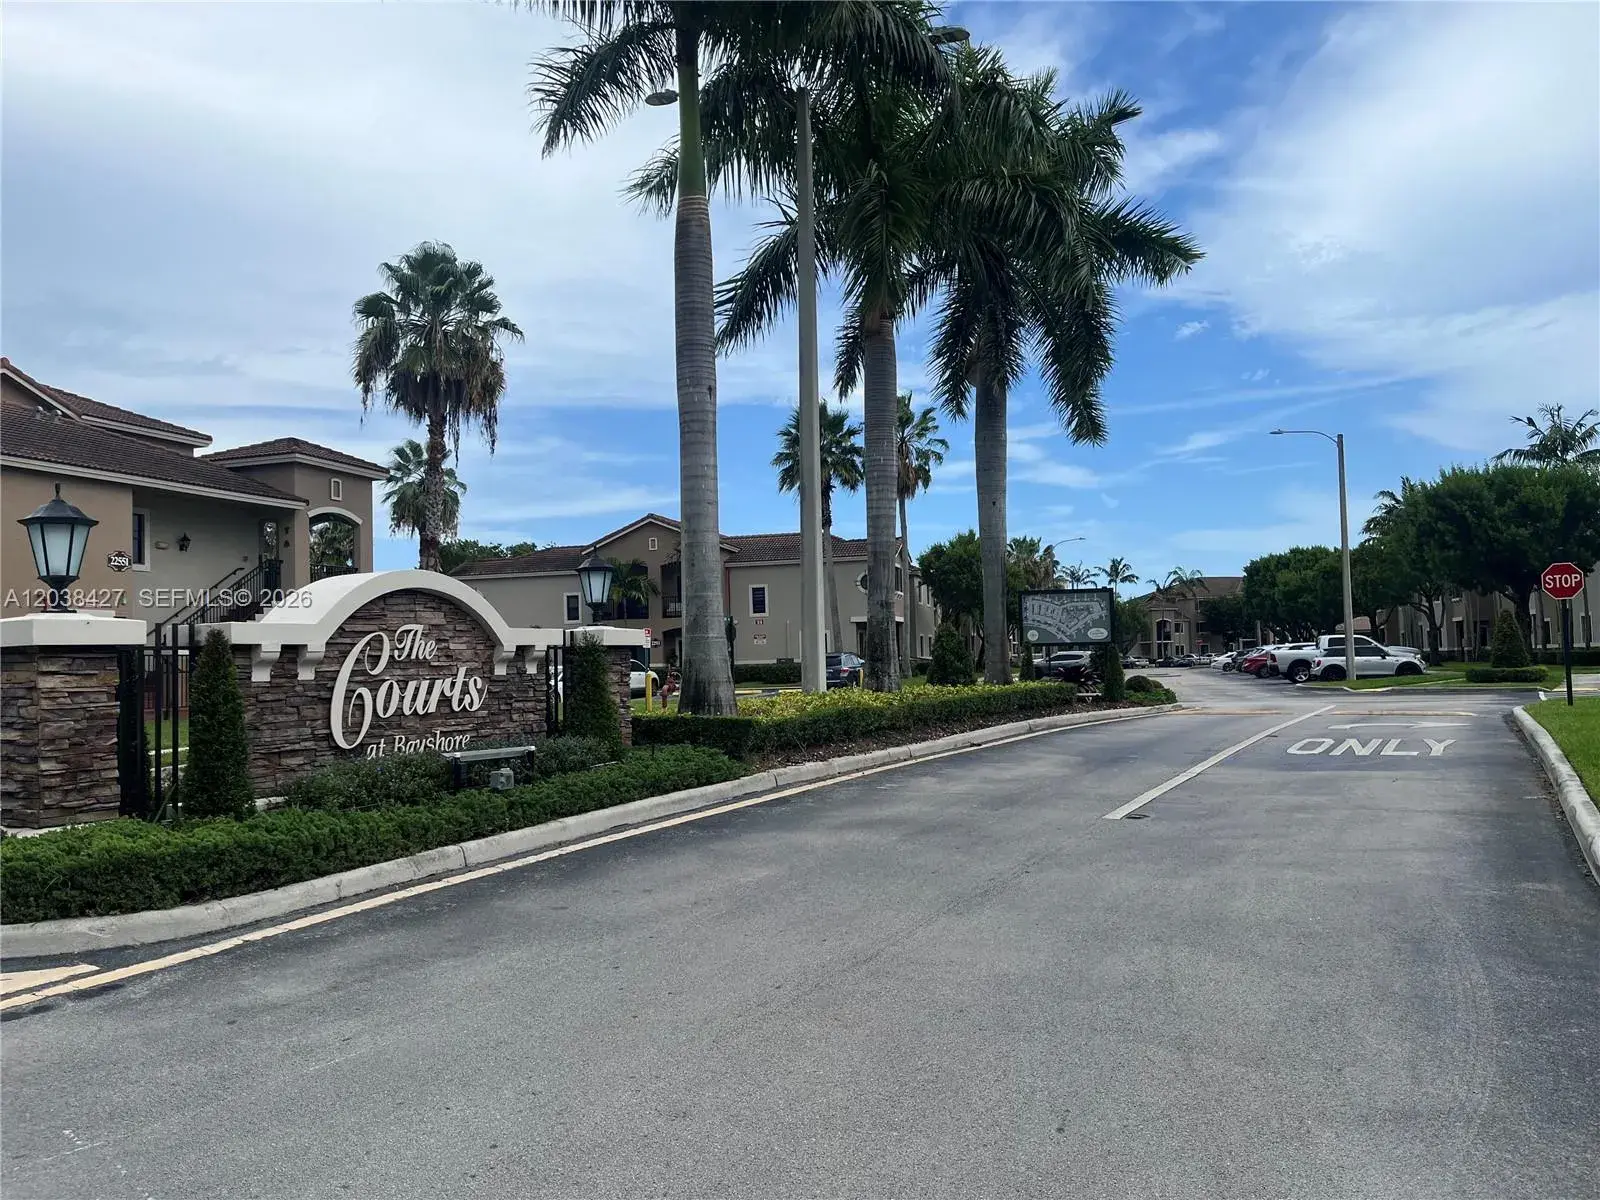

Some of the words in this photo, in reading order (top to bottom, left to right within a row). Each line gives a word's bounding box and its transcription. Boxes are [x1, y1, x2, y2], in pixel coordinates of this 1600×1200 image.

[1545, 574, 1581, 588] STOP
[394, 624, 437, 660] The
[330, 632, 487, 749] Courts
[367, 738, 386, 760] at
[1287, 738, 1456, 756] ONLY
